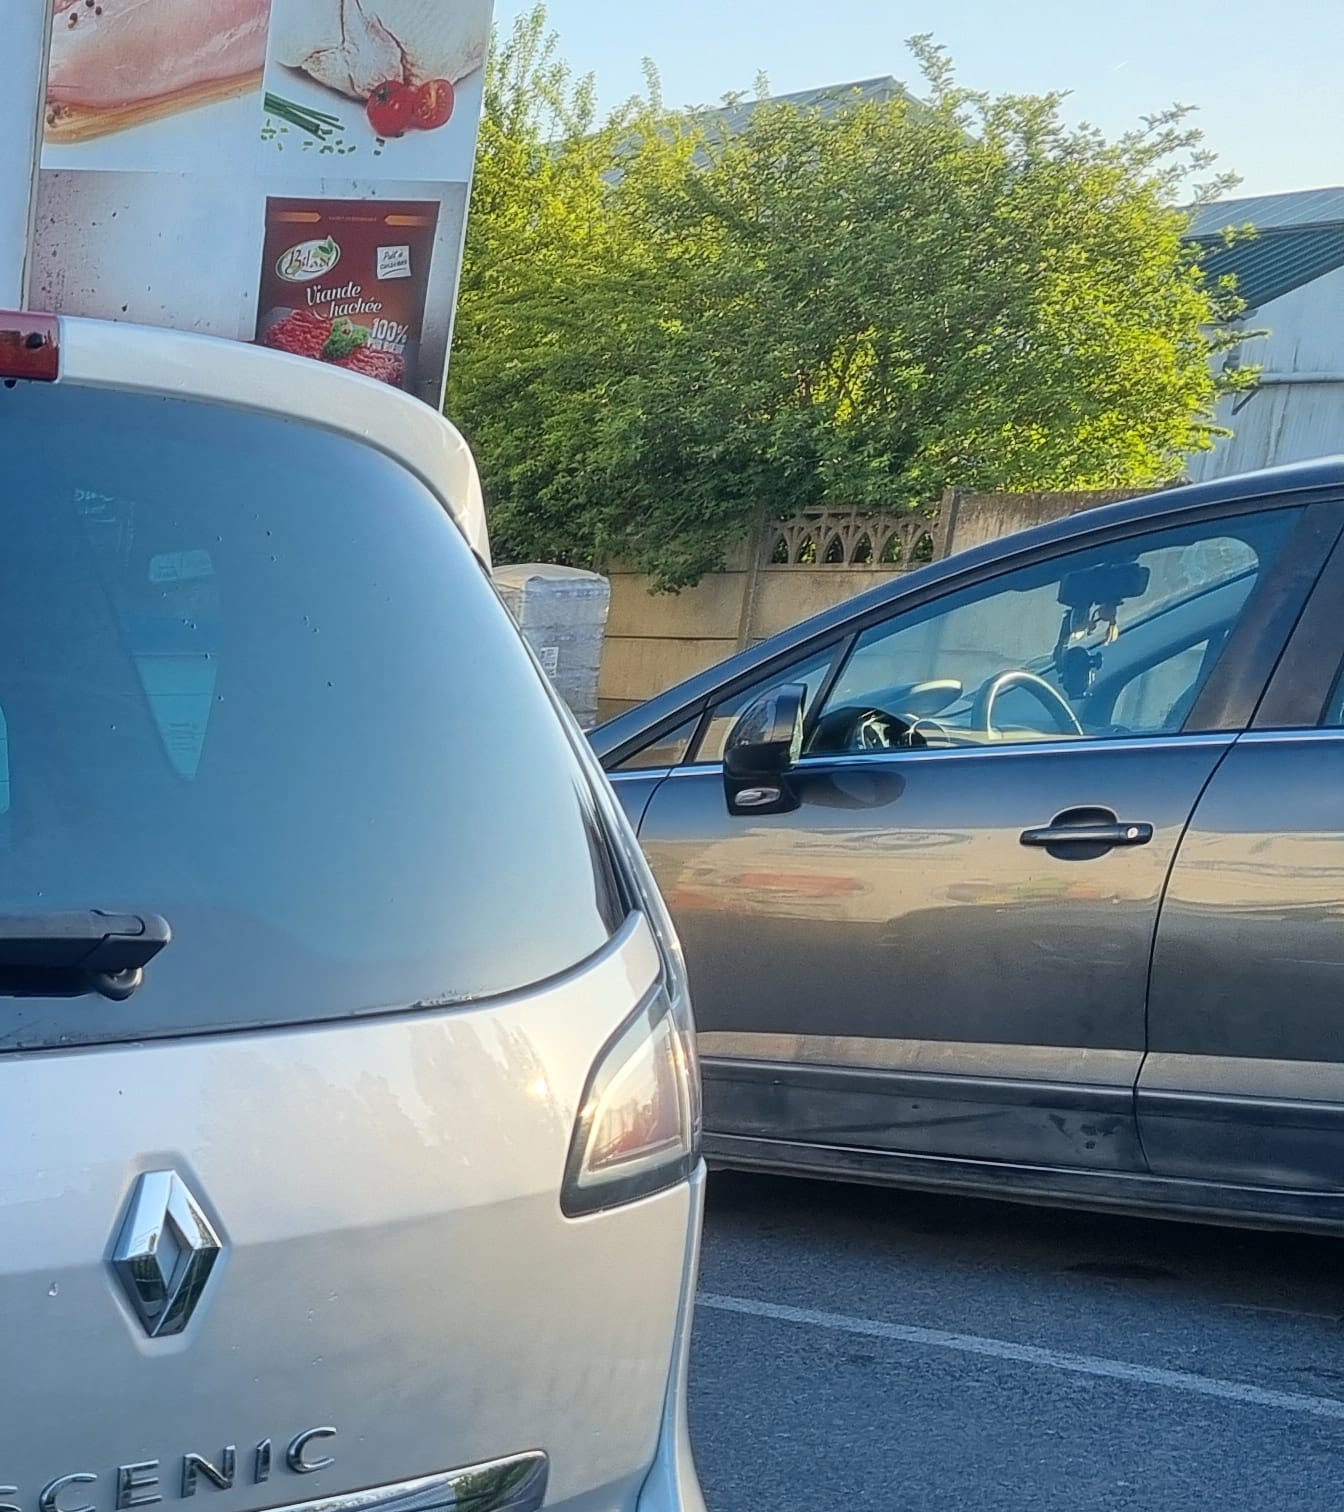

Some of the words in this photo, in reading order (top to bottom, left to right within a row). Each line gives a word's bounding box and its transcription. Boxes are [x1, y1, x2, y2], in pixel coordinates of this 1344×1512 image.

[306, 281, 361, 306] Viande
[314, 297, 382, 320] hachée
[373, 318, 408, 343] 100%
